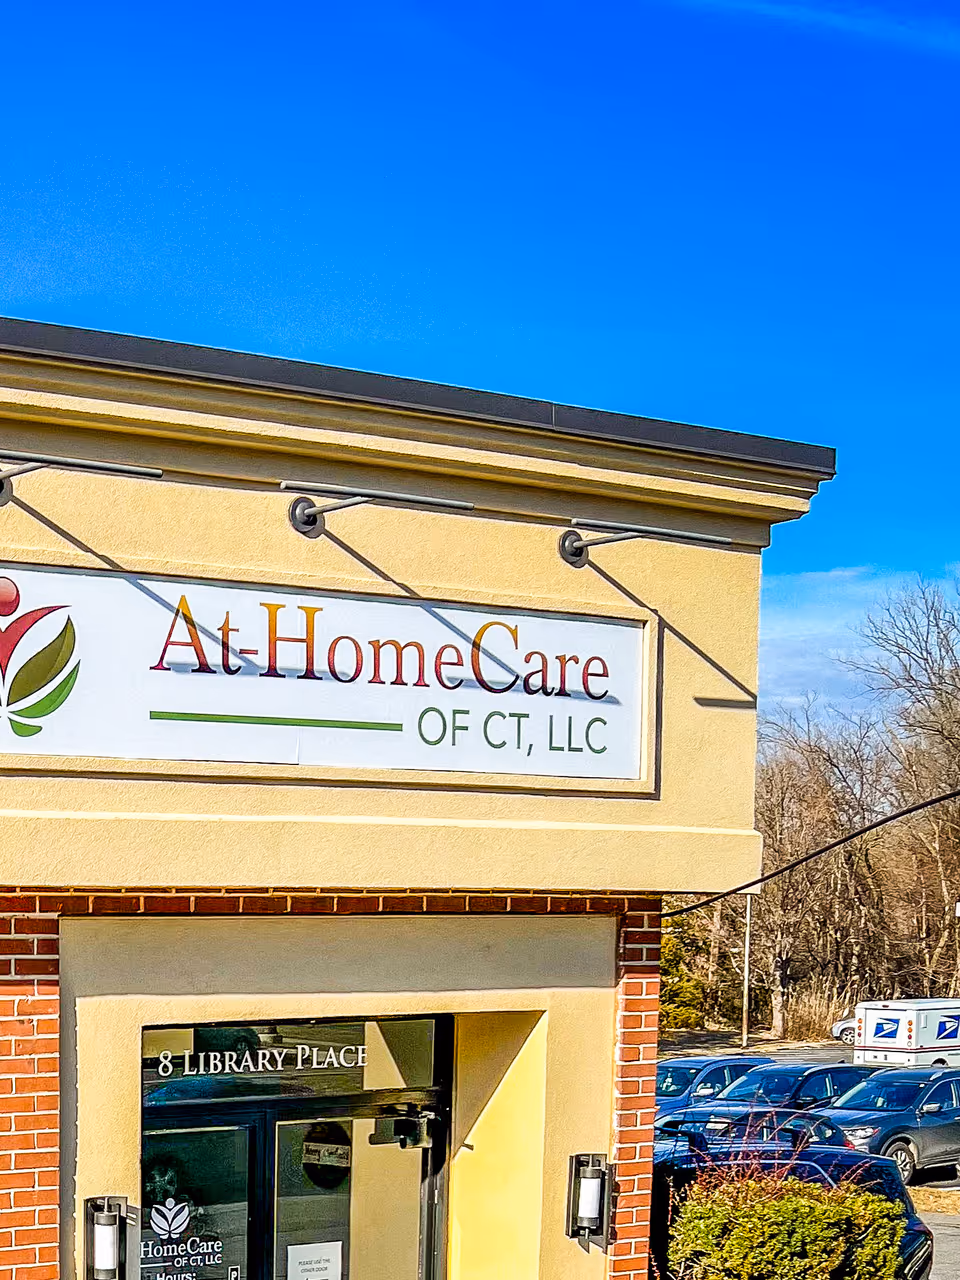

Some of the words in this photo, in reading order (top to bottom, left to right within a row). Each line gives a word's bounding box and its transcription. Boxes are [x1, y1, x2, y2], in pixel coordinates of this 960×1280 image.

[150, 595, 609, 700] At-HomeCare
[418, 707, 470, 746] OF
[483, 711, 533, 757] CT,
[548, 715, 608, 754] LLC
[158, 1050, 173, 1076] 8
[183, 1049, 289, 1076] LIBRARY
[296, 1044, 369, 1070] PLACE
[140, 1237, 223, 1258] HomeCare
[174, 1257, 188, 1267] OF
[189, 1255, 203, 1266] CT,
[205, 1254, 222, 1264] LLC
